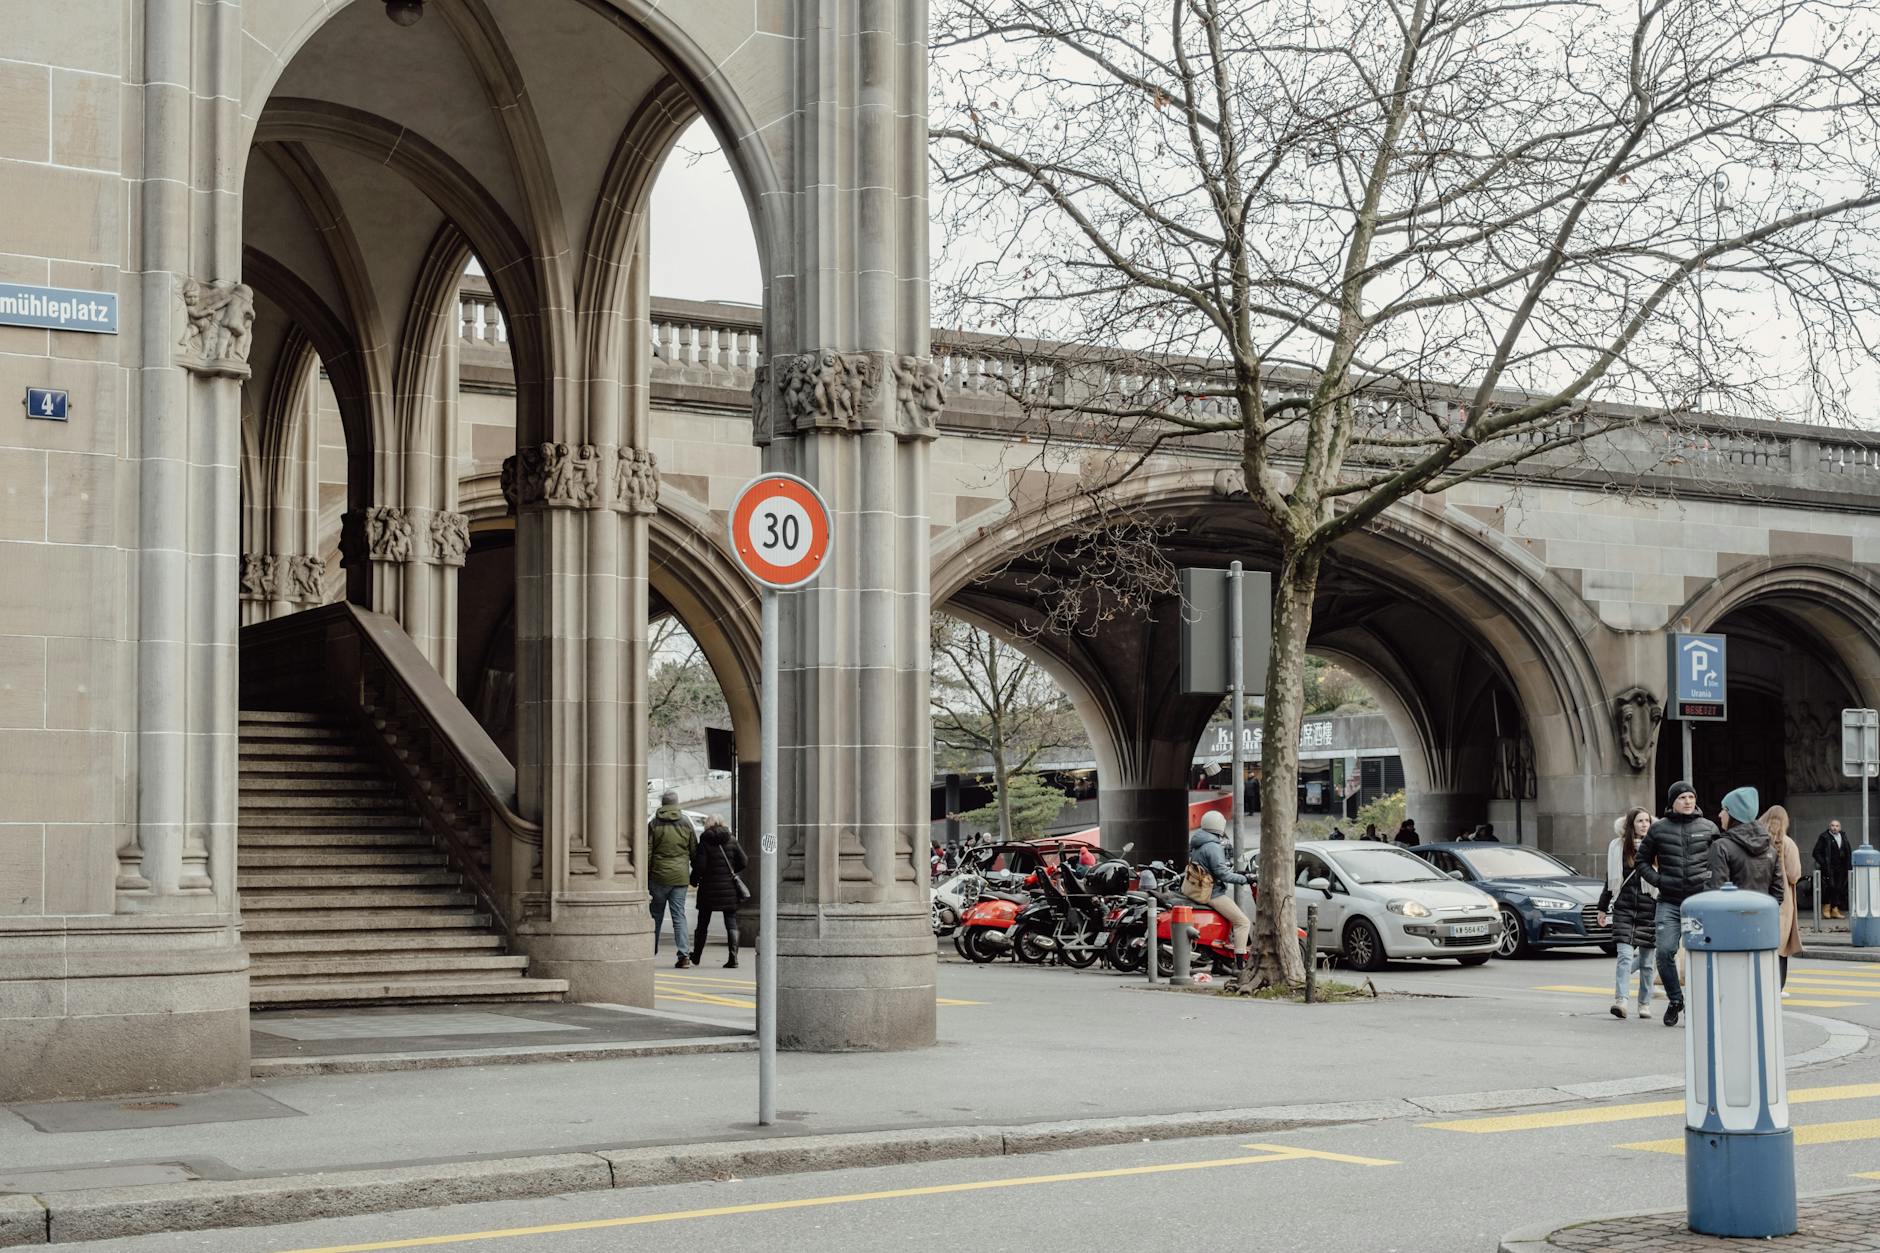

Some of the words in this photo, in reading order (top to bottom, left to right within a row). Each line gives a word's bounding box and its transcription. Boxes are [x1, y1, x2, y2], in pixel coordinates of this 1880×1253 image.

[0, 293, 109, 323] mühleplatz
[41, 393, 54, 416] 4
[762, 512, 800, 551] 30
[1692, 650, 1708, 681] P
[1691, 688, 1712, 698] Urania
[1684, 705, 1717, 716] BESETZT
